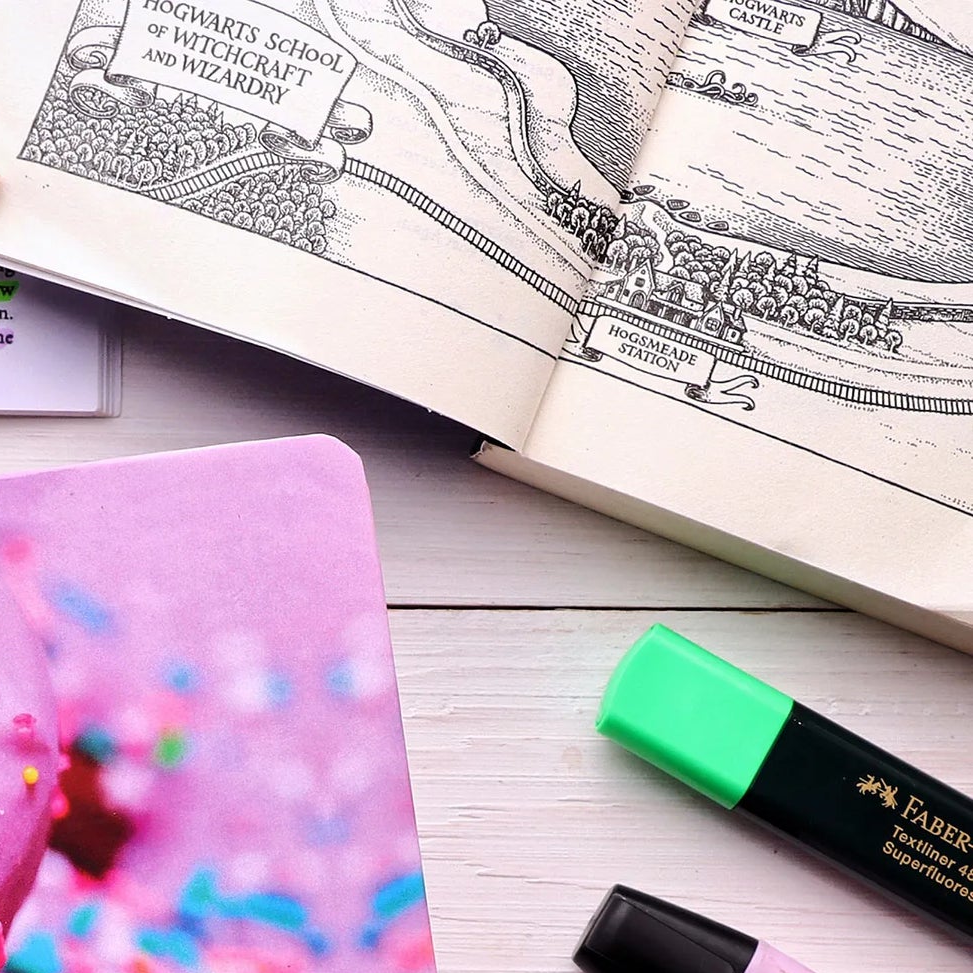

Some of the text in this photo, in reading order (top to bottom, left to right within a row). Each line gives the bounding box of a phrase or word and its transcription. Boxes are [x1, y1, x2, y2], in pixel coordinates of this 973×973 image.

[142, 0, 344, 74] HOGWARTS SCHOOL
[729, 7, 785, 35] CASTLE
[142, 47, 291, 105] AND WIZARDRY
[147, 23, 313, 87] OF WITCHCRAFT
[608, 324, 698, 366] HOGSMEADE
[617, 342, 680, 373] STATION
[891, 824, 957, 869] Textliner
